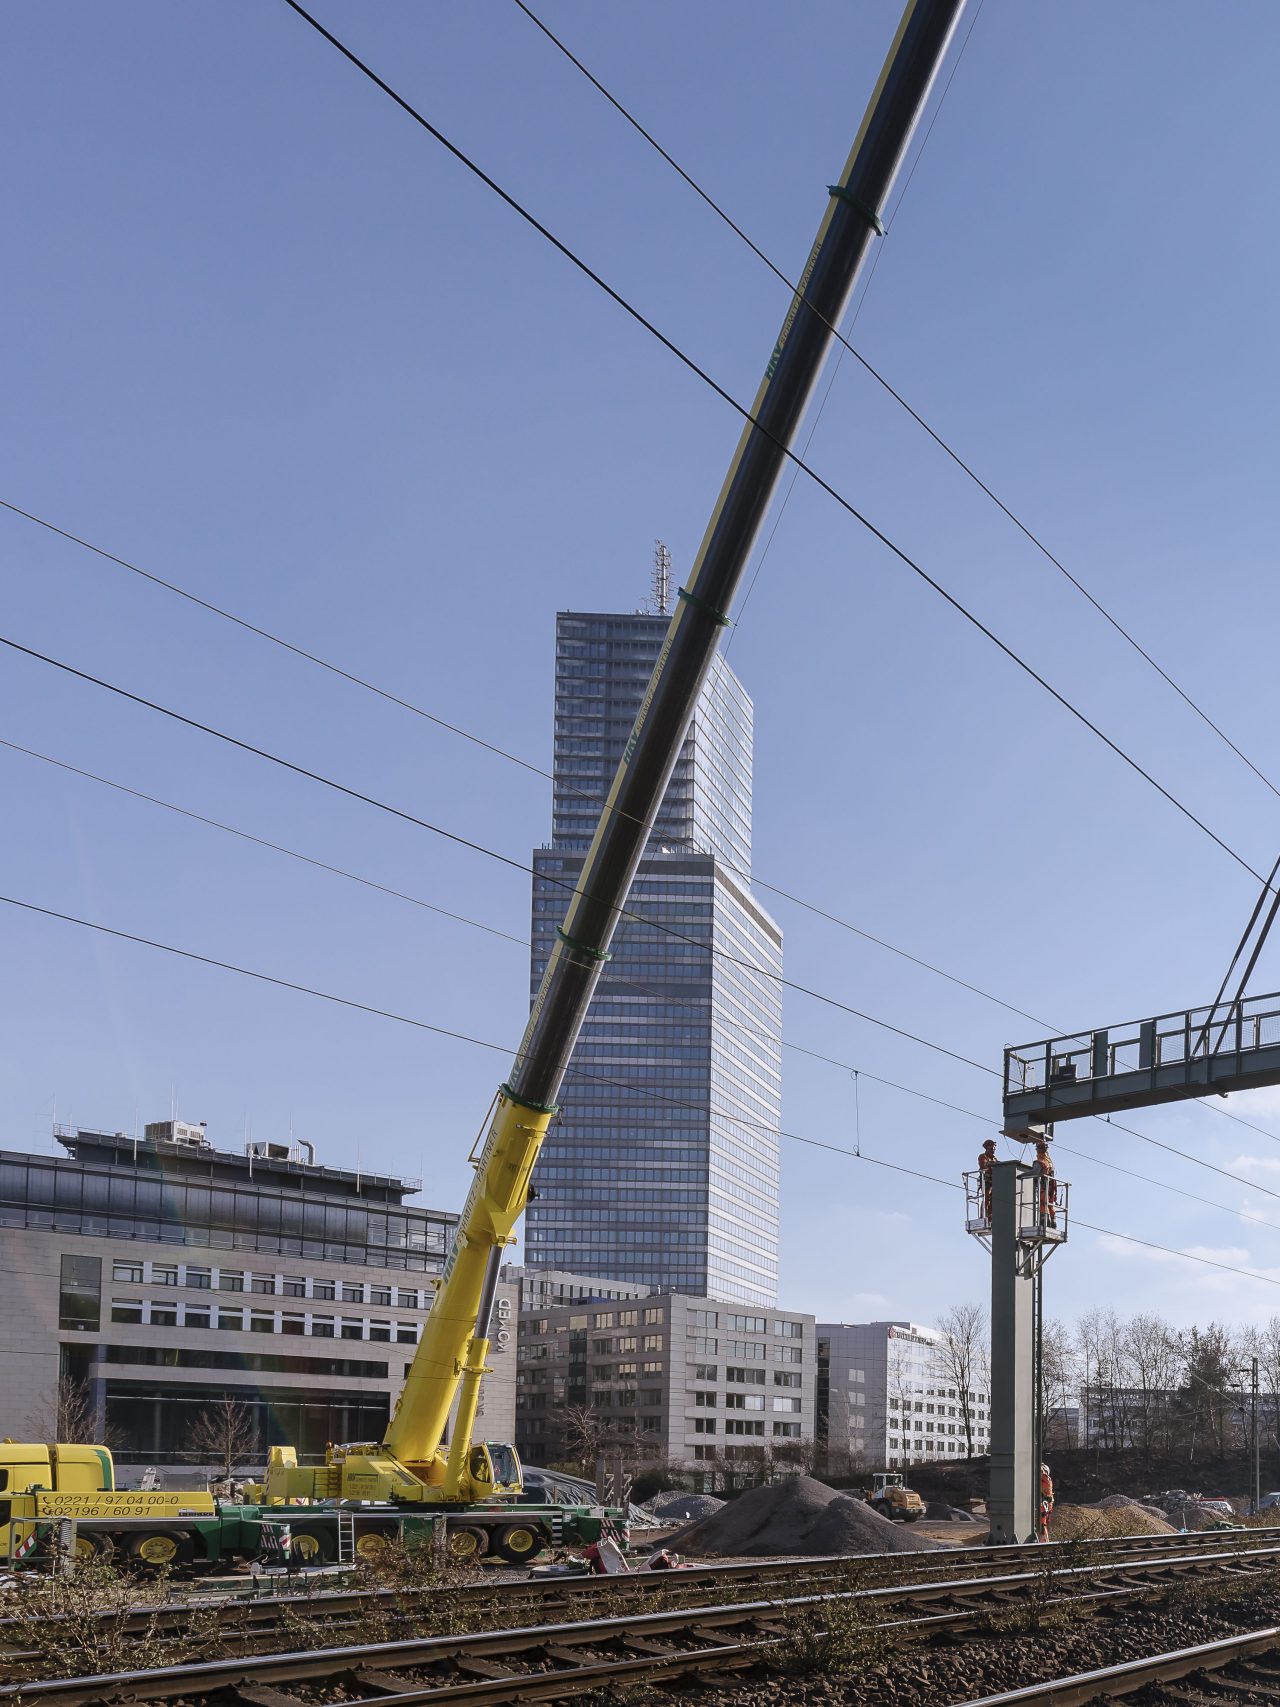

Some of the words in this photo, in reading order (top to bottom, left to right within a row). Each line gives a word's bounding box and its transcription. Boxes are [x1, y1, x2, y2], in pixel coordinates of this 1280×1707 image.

[475, 1128, 498, 1183] PARTNER
[54, 1495, 90, 1506] 0221
[95, 1495, 102, 1506] /
[105, 1495, 123, 1505] 97
[126, 1495, 144, 1505] 04
[148, 1495, 179, 1505] 00-0
[54, 1506, 100, 1516] 02196
[103, 1506, 110, 1516] /
[113, 1506, 131, 1516] 60
[134, 1506, 151, 1516] 91
